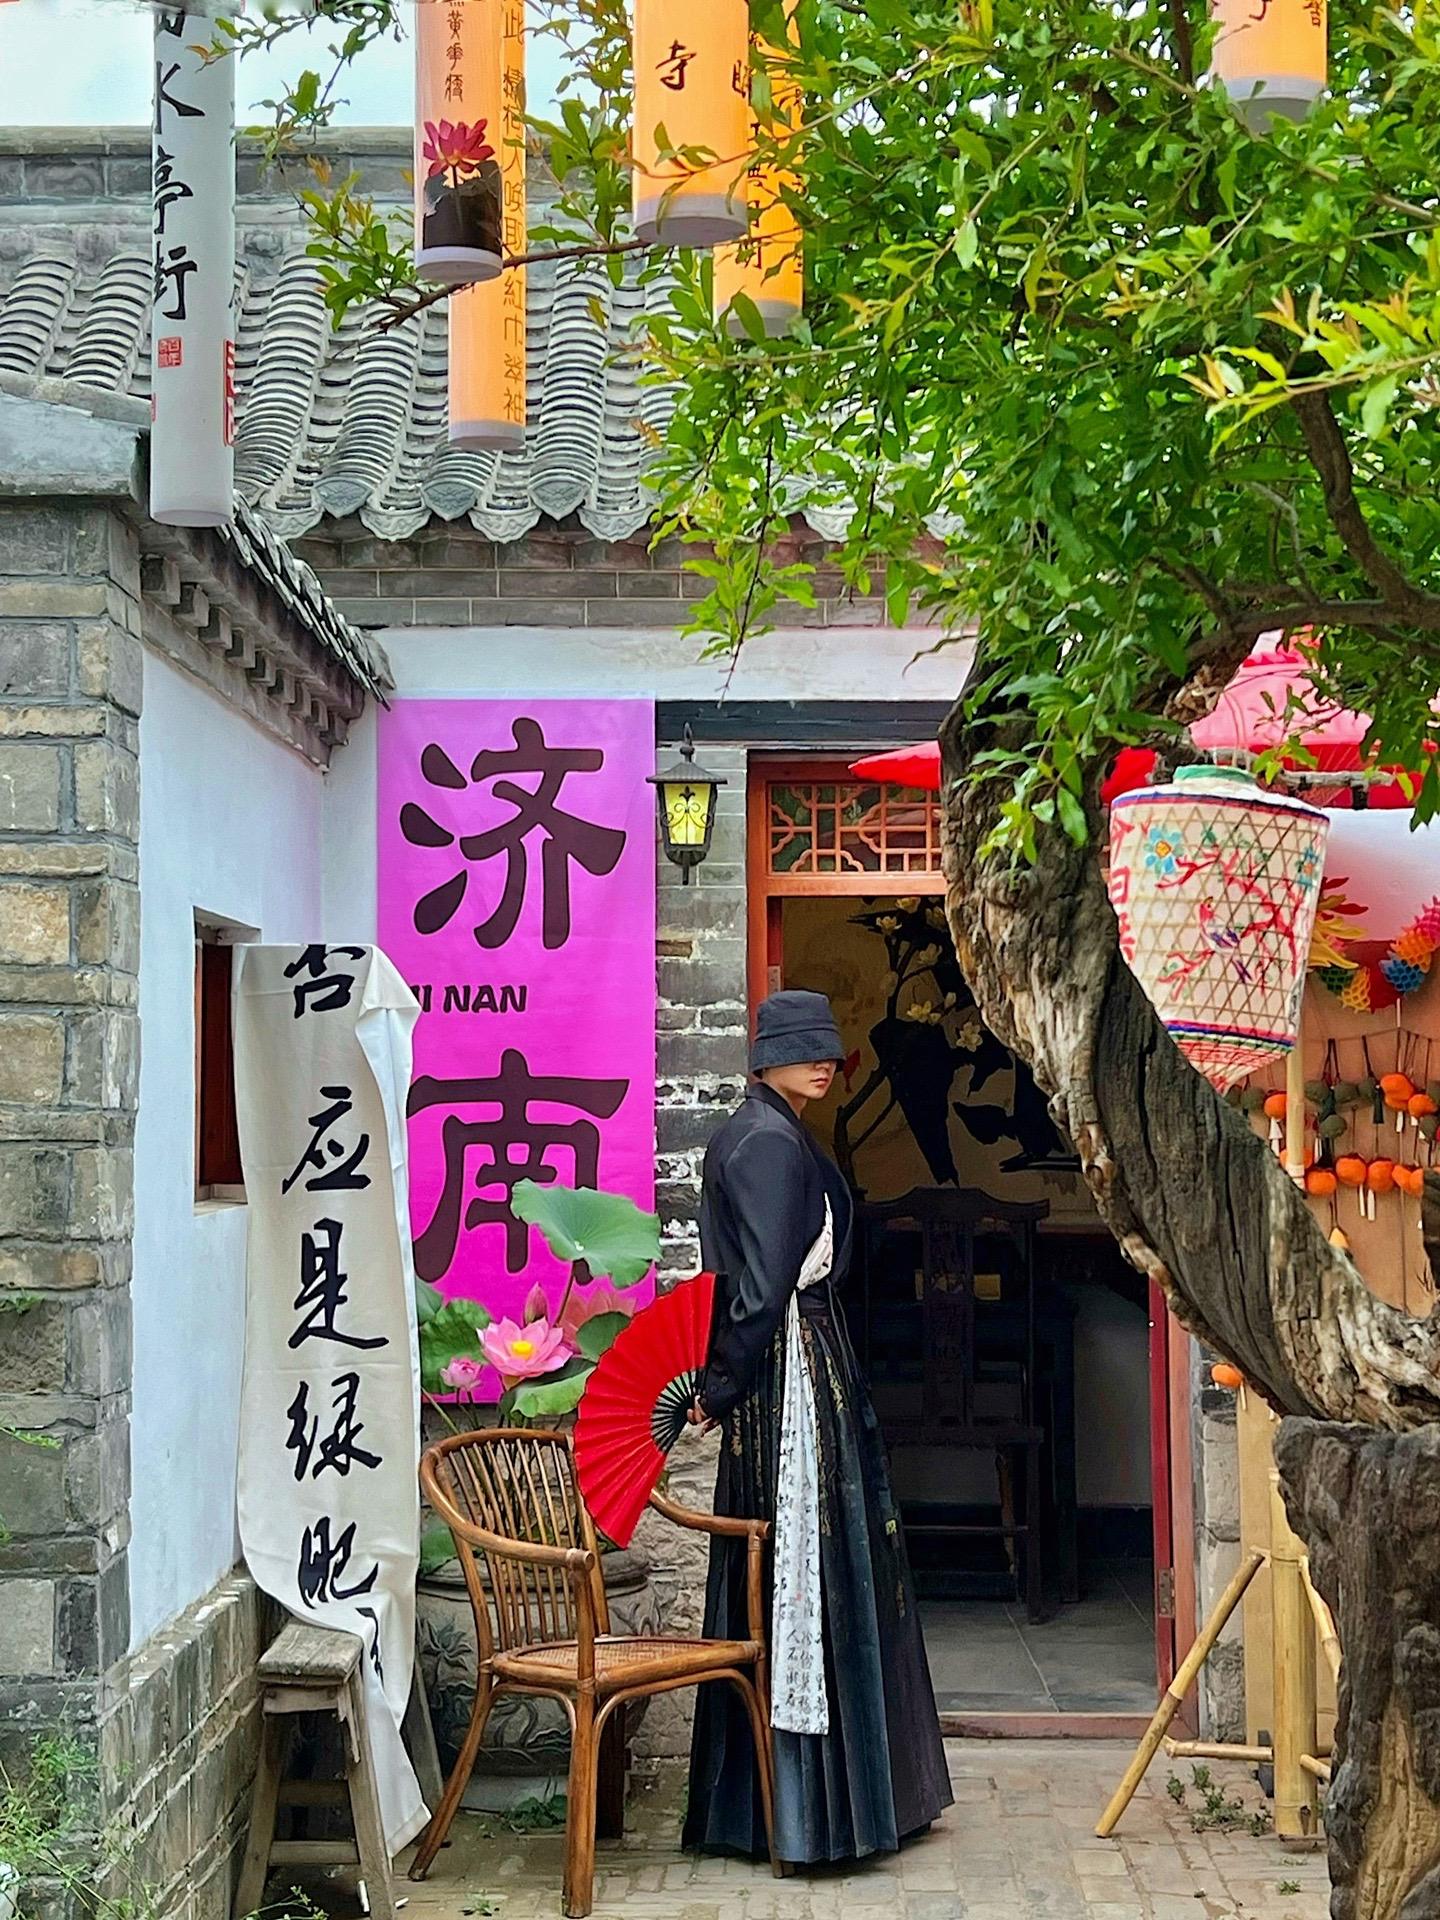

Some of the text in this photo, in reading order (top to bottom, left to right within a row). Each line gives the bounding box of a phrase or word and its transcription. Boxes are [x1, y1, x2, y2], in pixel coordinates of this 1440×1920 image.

[655, 39, 697, 91] 寺
[399, 717, 627, 950] 济
[443, 985, 528, 1013] NAN
[405, 1048, 630, 1285] 南
[282, 943, 390, 1690] 否应是绿肥
